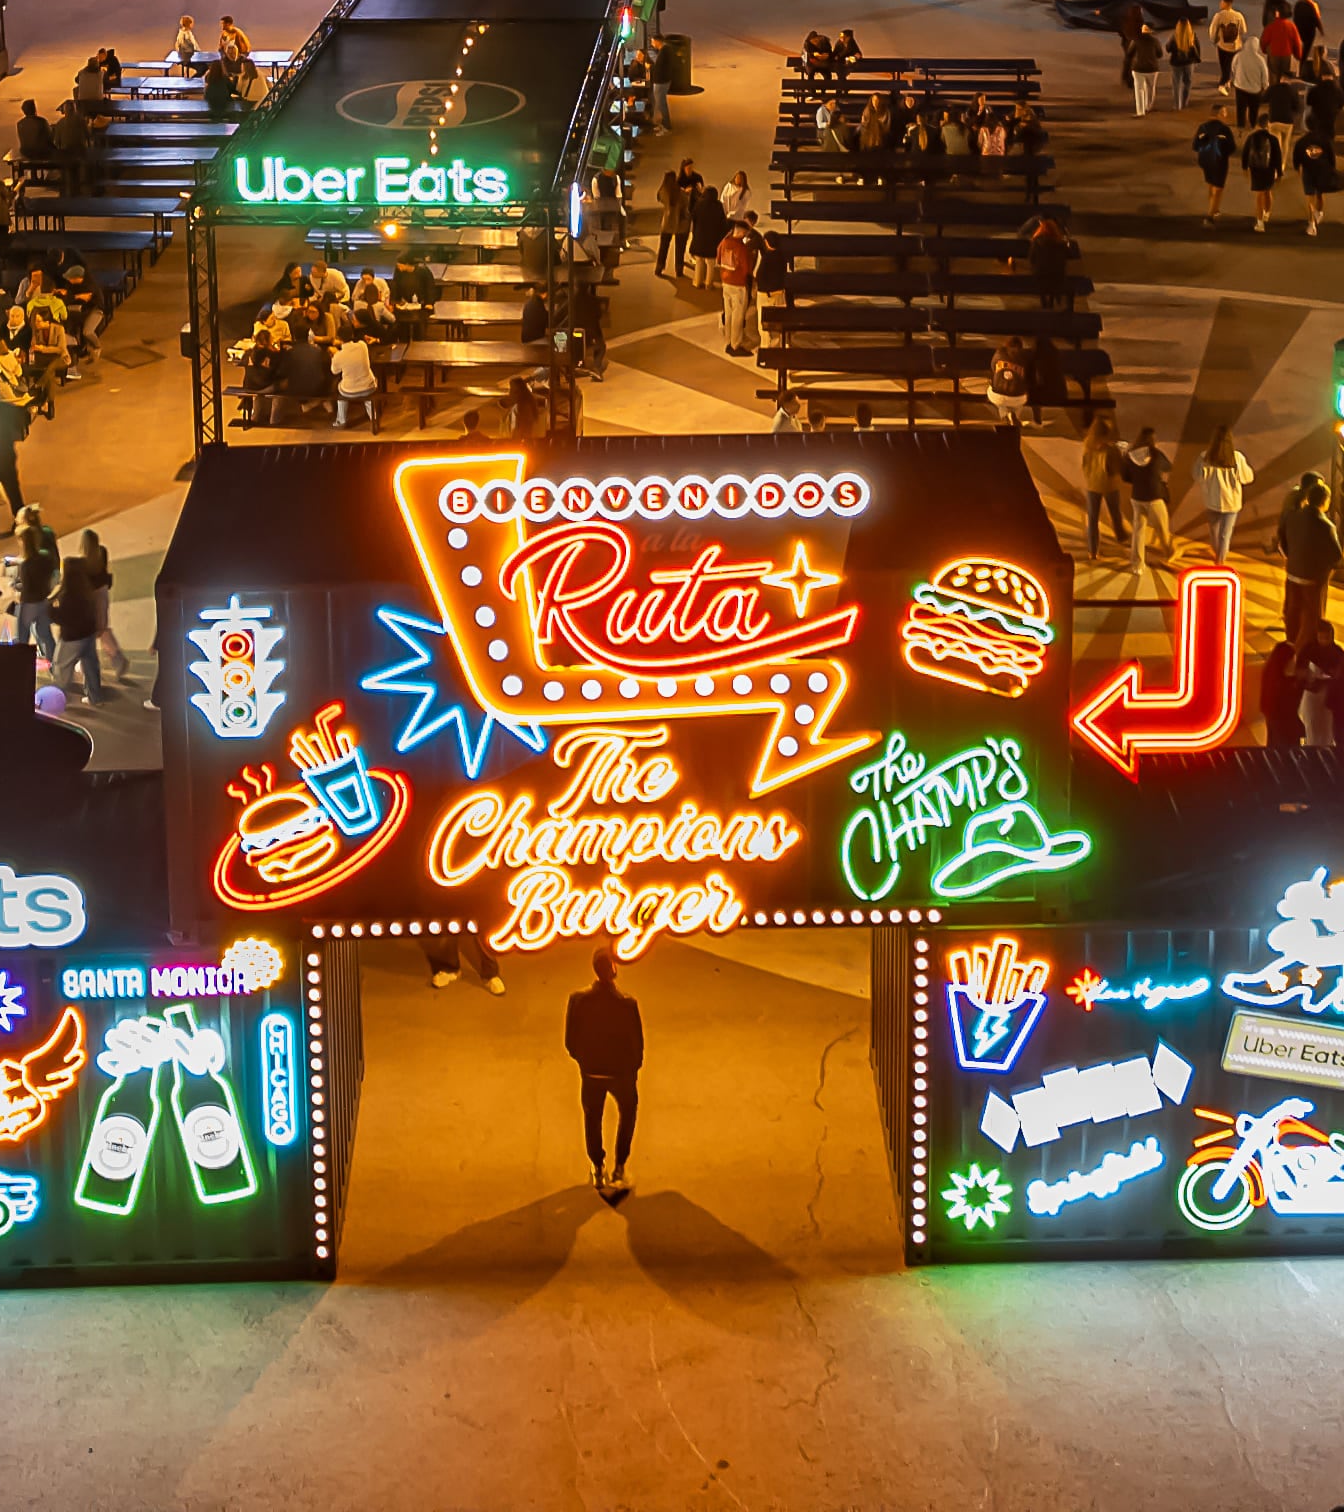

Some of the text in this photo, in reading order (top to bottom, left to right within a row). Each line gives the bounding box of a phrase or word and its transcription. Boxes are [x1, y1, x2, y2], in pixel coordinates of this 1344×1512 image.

[236, 157, 511, 204] Uber Eats
[450, 481, 860, 515] BIENVENIDOS
[499, 521, 826, 673] Ruta
[552, 724, 679, 819] The
[851, 731, 925, 801] The
[428, 790, 802, 887] Champions
[841, 737, 1029, 901] CHAMP'S
[489, 864, 746, 962] Burger
[62, 966, 253, 999] SANTA MONICA
[268, 1019, 290, 1138] CHICAGO
[1242, 1034, 1297, 1060] Uber
